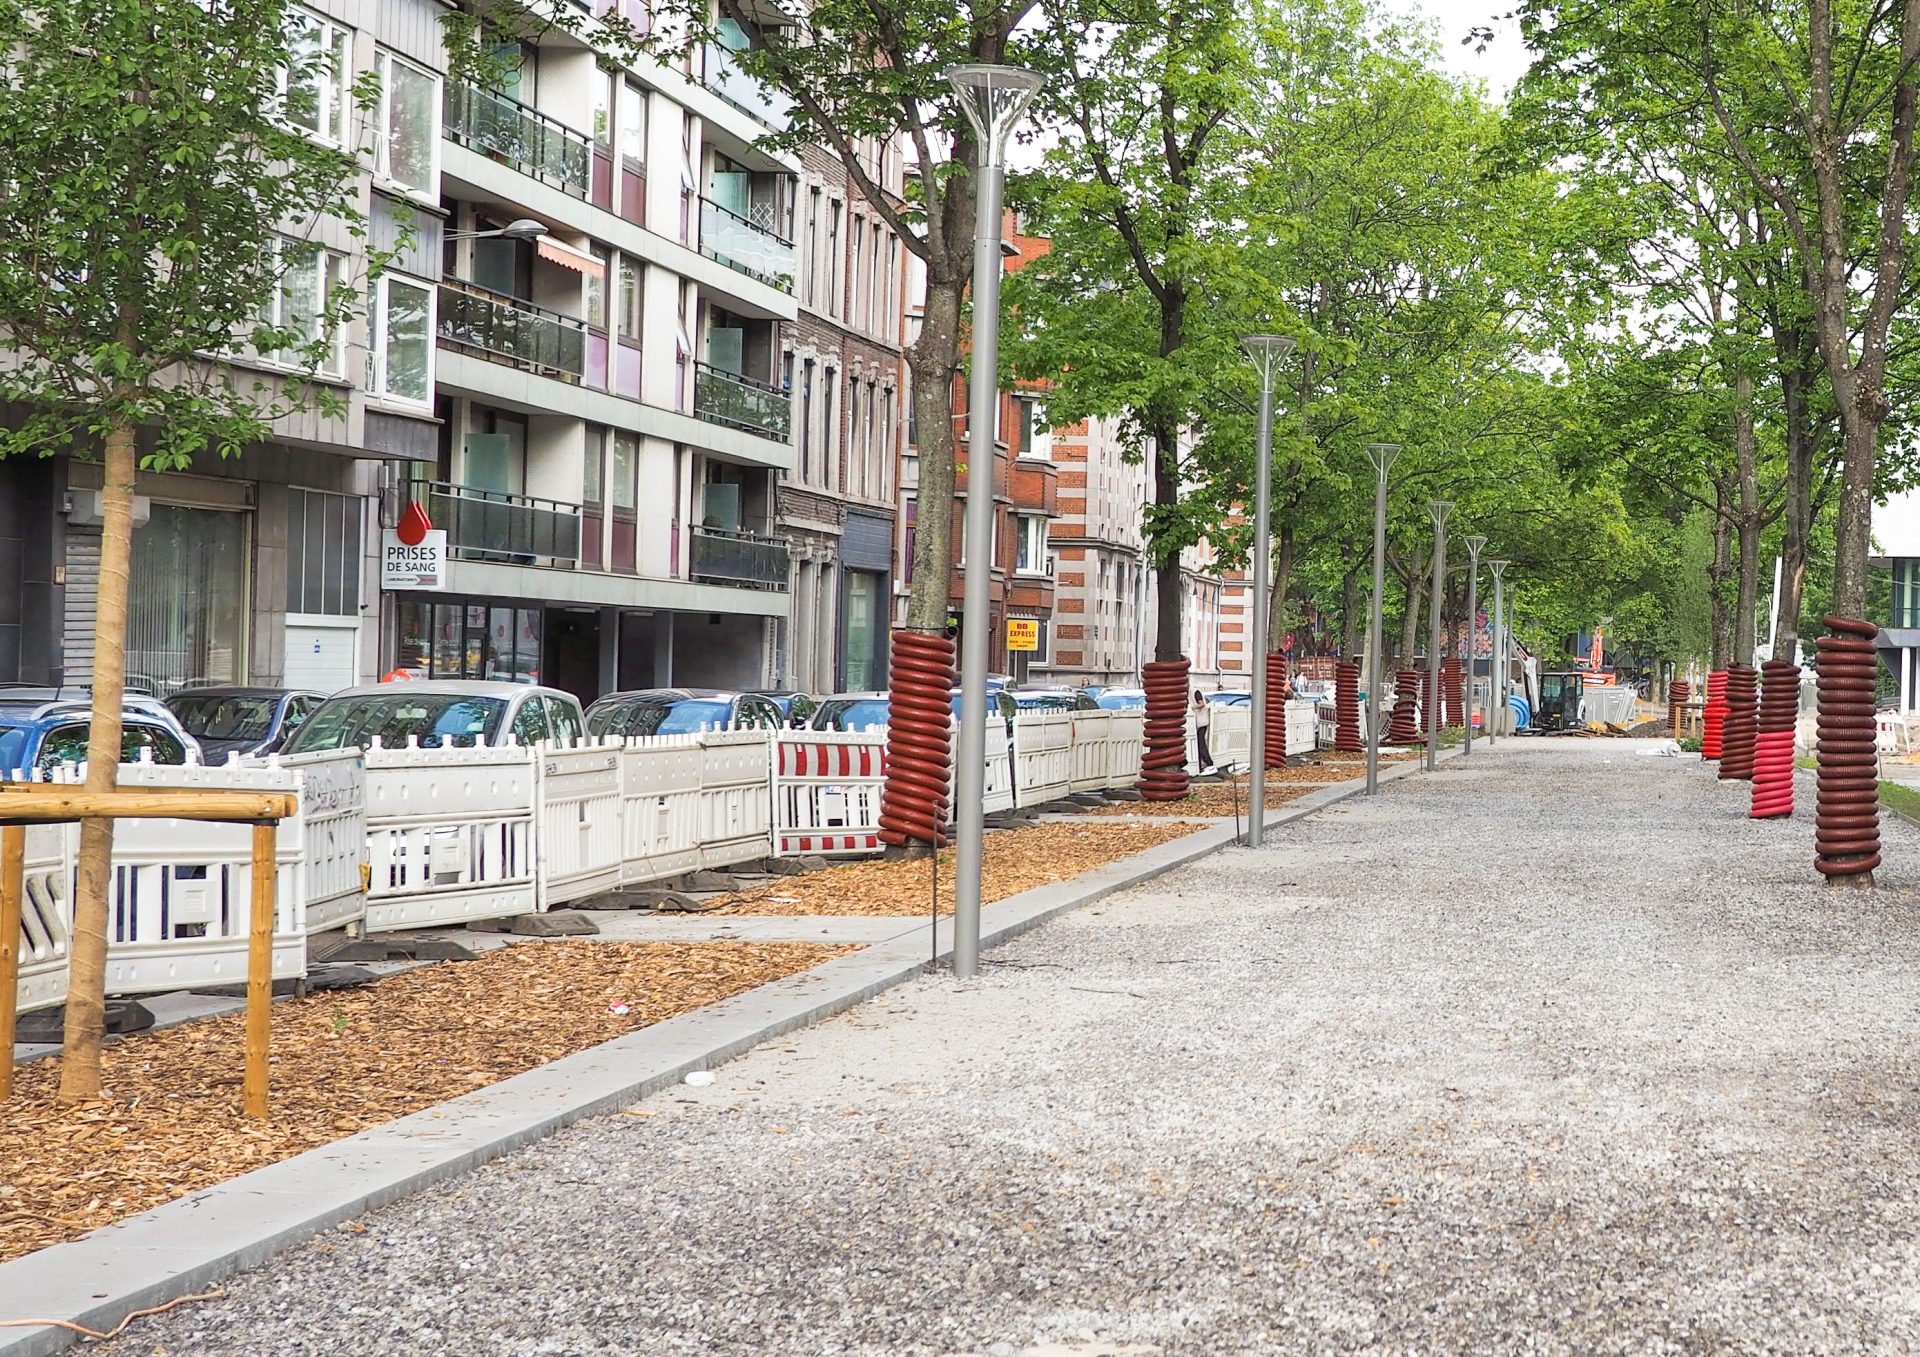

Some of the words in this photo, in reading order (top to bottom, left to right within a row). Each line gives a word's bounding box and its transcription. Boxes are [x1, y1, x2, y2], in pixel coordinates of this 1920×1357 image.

[387, 547, 436, 560] PRISES
[387, 562, 401, 572] DE
[405, 562, 436, 572] SANG
